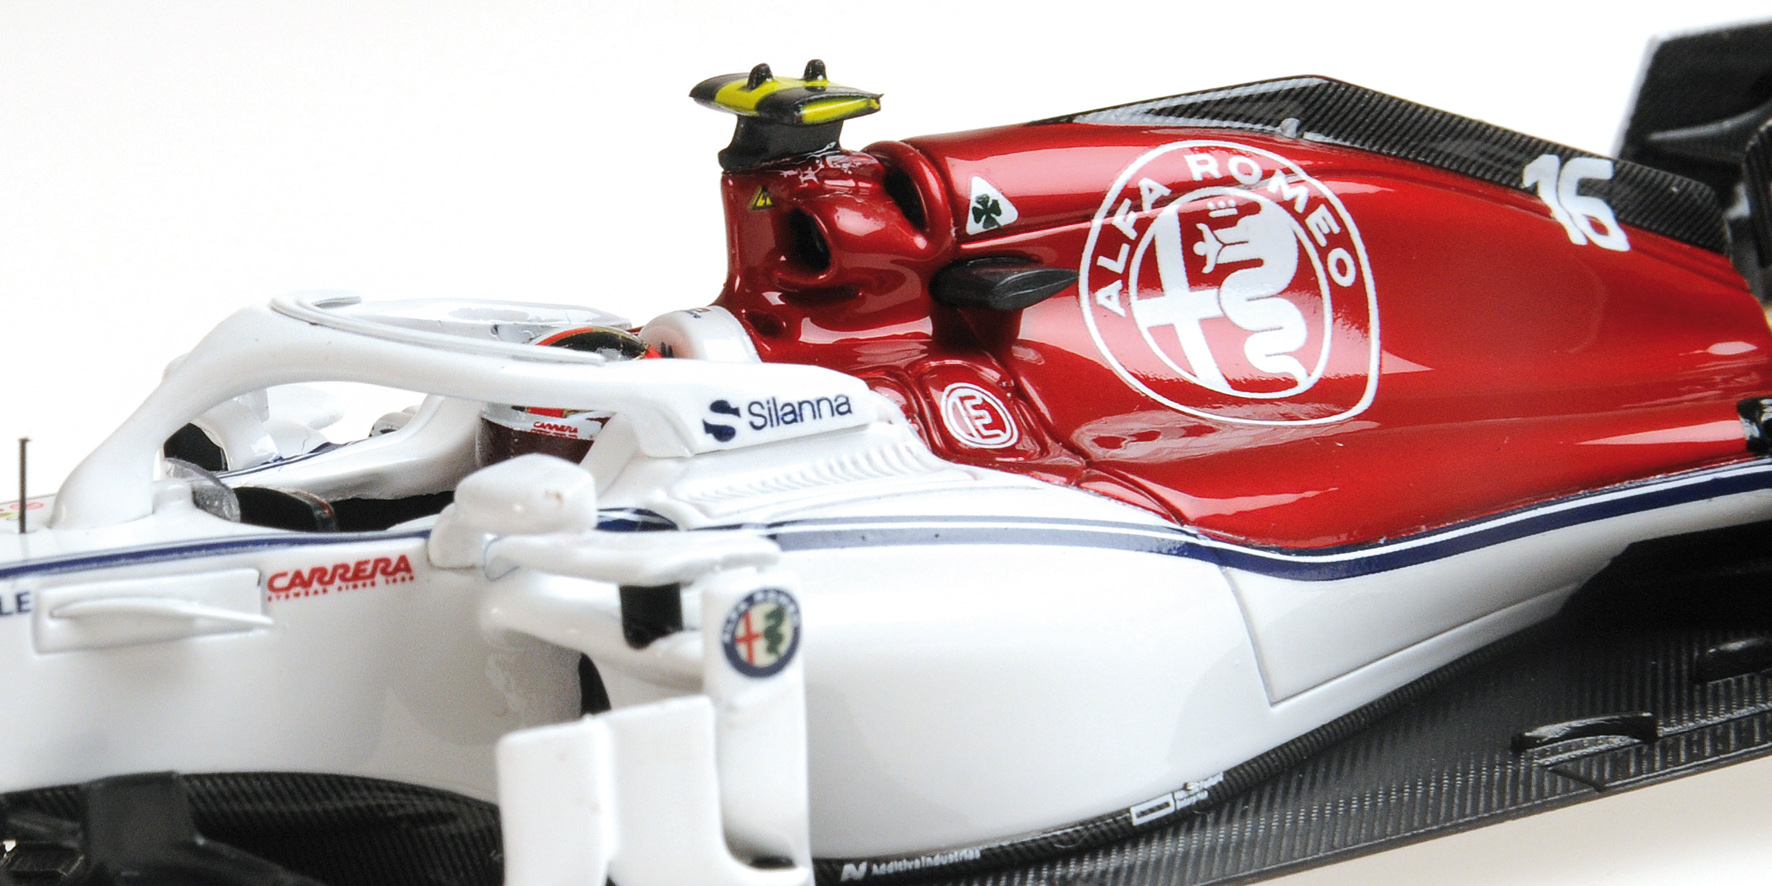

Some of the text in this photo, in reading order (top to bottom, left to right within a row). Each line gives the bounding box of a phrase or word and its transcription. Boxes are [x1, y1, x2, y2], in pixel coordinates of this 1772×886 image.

[1094, 153, 1357, 318] ALFA ROMEO
[1522, 153, 1632, 252] 16
[748, 394, 853, 431] Silanna
[267, 554, 413, 593] CARRERA
